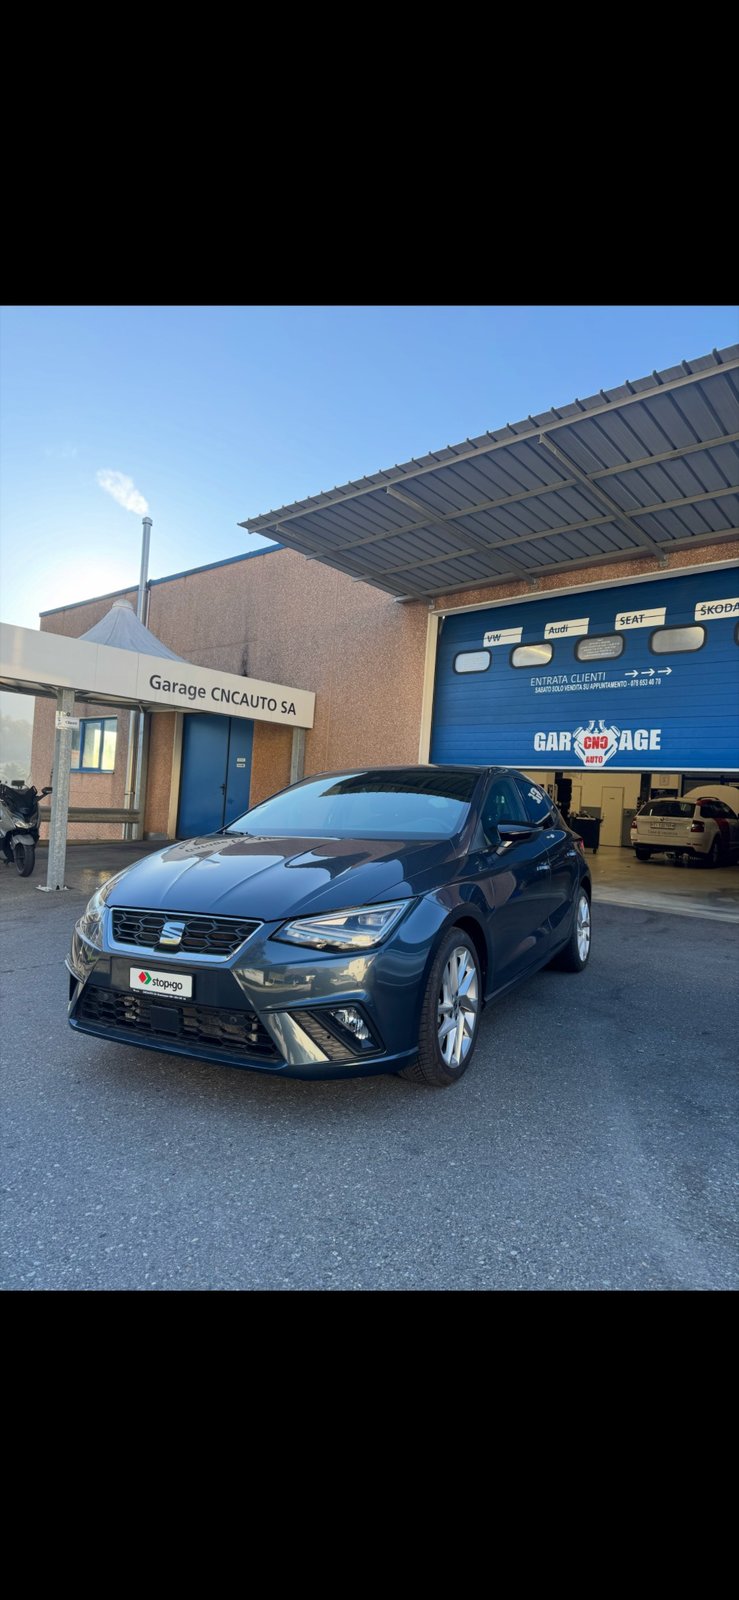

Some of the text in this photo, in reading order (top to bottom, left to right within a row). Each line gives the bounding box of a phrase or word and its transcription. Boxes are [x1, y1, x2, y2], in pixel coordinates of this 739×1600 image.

[700, 602, 739, 616] ŠKODA
[619, 613, 646, 625] SEAT
[548, 624, 569, 635] Audi
[486, 633, 502, 643] VW
[530, 672, 606, 687] ENTRATA CLIENTI
[535, 685, 552, 694] SABATO
[552, 684, 564, 693] SOLO
[564, 683, 583, 692] VENDITA
[583, 682, 590, 691] SU
[590, 680, 628, 690] APPUNTAMENTO
[149, 674, 297, 715] Garage CNCAUTO SA
[533, 732, 572, 751] GAR
[618, 729, 662, 750] AGE
[585, 755, 603, 764] AUTO
[152, 978, 183, 992] stop+go
